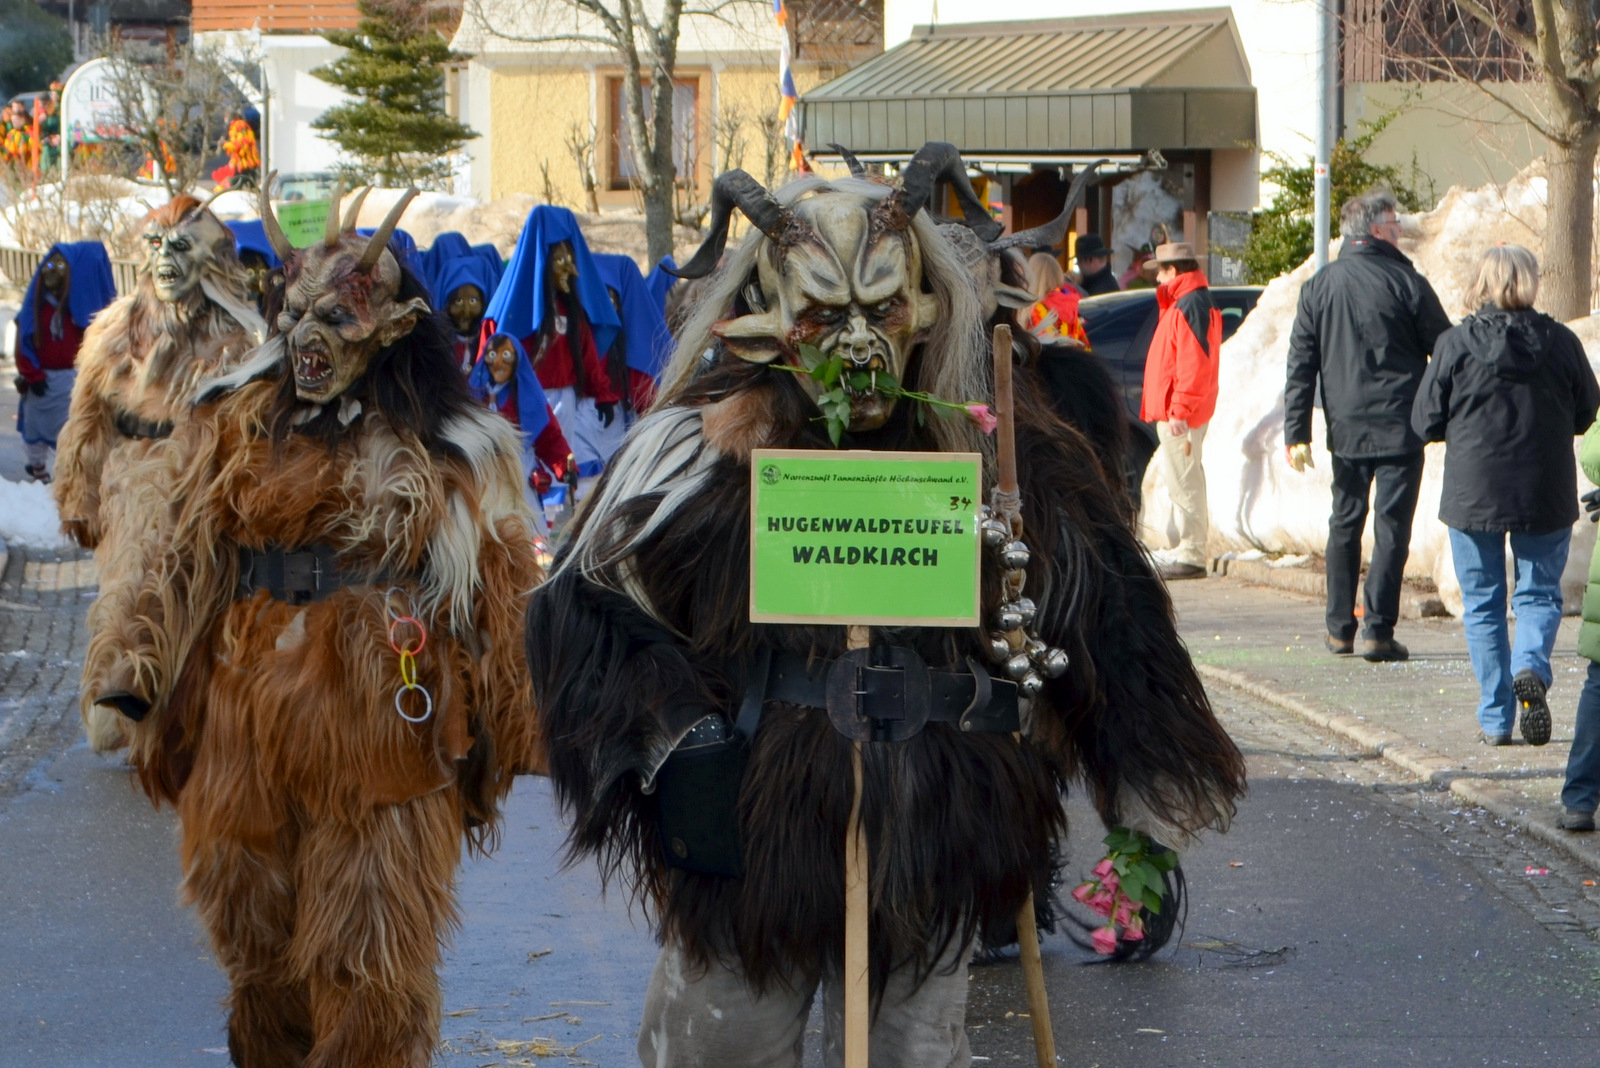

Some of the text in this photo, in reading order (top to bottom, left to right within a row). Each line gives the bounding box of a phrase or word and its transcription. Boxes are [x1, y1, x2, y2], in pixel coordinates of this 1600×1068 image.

[782, 473, 831, 482] Narrenzunft
[832, 474, 887, 483] Tannenzäpfle
[889, 475, 953, 483] Höchenschwand
[950, 496, 972, 511] 34
[767, 516, 965, 535] HUGENWALDTEUFEL
[792, 545, 938, 567] WALDKIRCH
